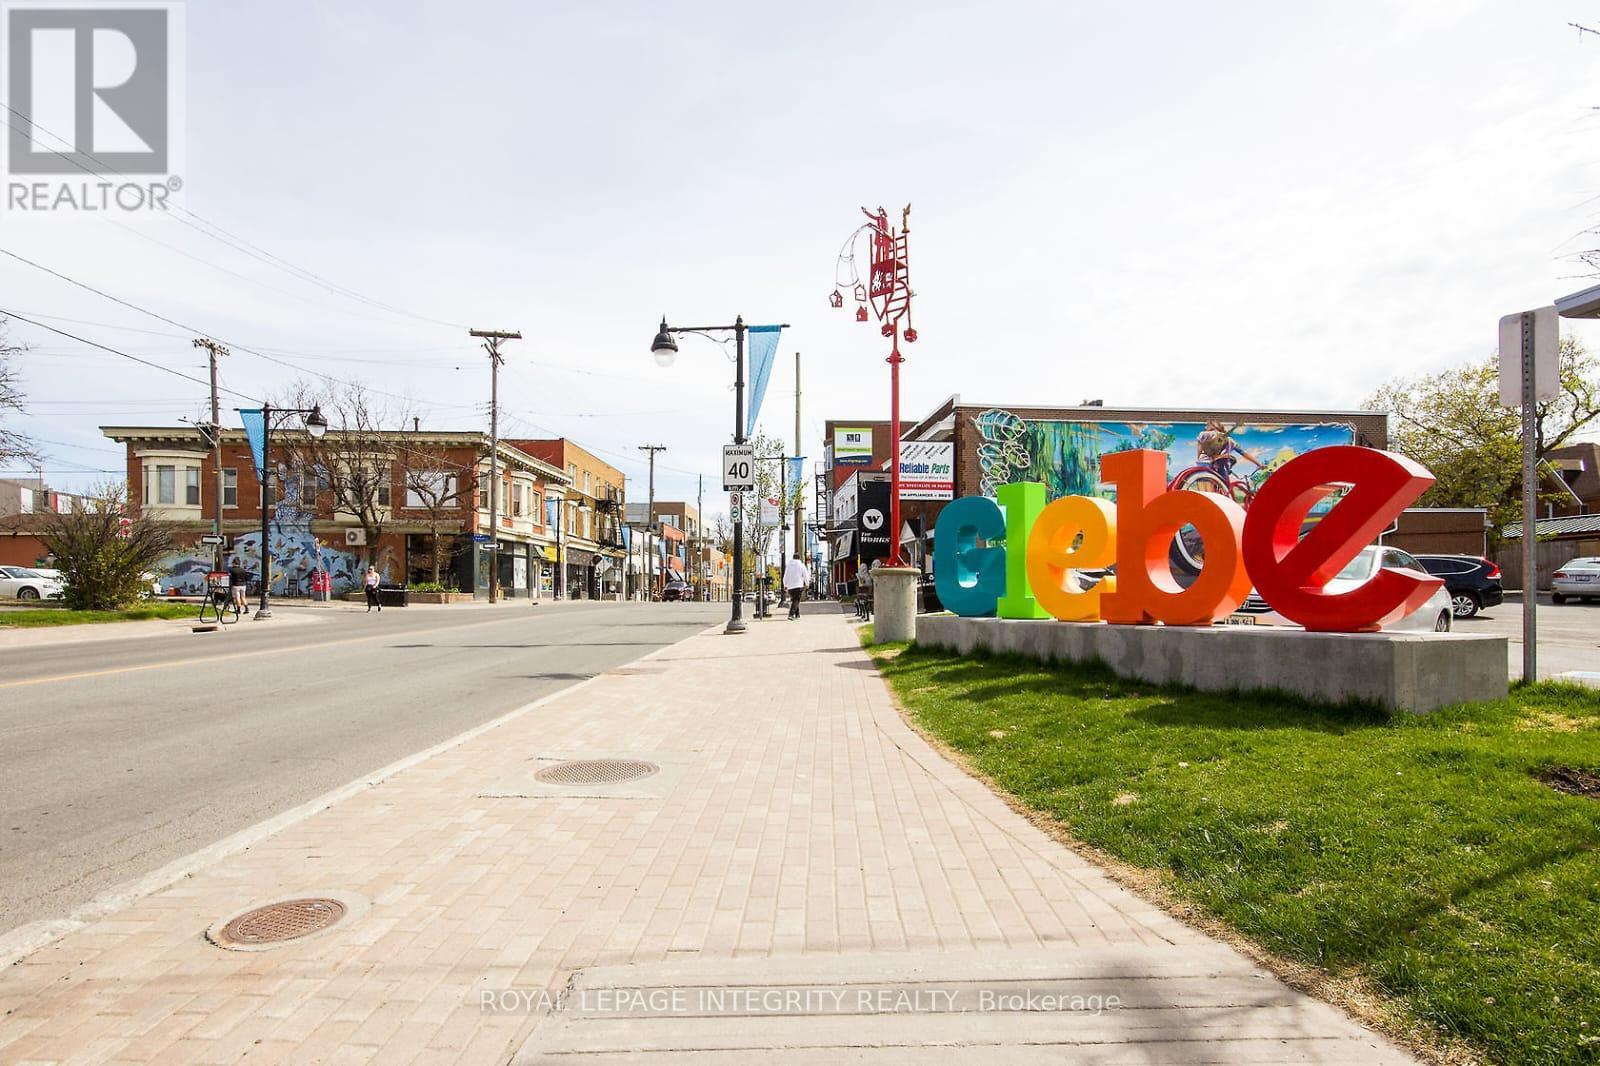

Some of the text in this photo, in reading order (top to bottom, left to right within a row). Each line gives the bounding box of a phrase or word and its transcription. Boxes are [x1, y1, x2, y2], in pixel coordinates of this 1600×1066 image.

[728, 462, 749, 479] 40
[900, 463, 951, 474] Reliable Parts
[866, 516, 880, 524] W
